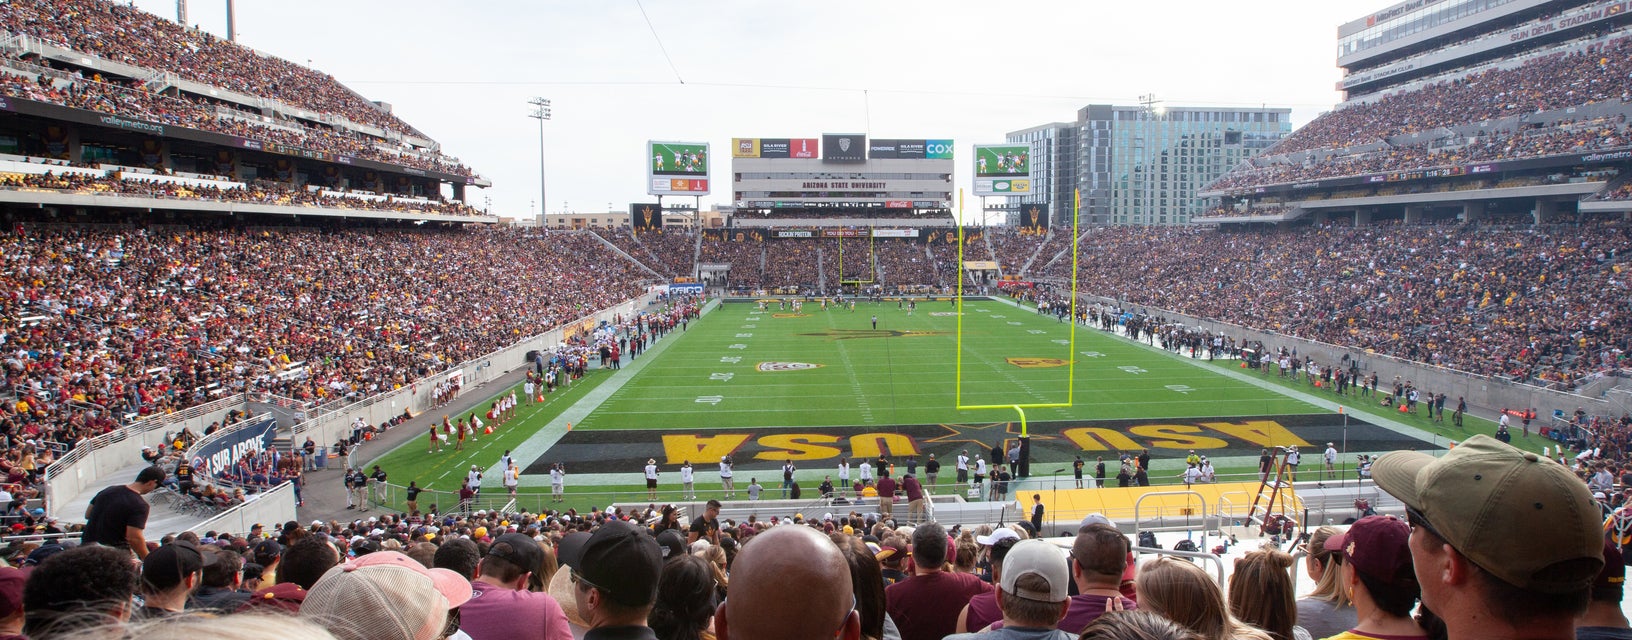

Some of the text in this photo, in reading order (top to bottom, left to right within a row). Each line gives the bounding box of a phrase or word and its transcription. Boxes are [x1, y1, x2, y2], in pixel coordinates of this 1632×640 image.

[1510, 10, 1601, 42] SUN DEVIL STADIUM
[1373, 68, 1397, 79] STADIUM
[1397, 64, 1414, 72] CLUB
[99, 116, 164, 136] valleymetro.org
[926, 144, 953, 154] COX
[1062, 420, 1315, 451] ASU
[206, 434, 266, 478] A SUB ABOVE
